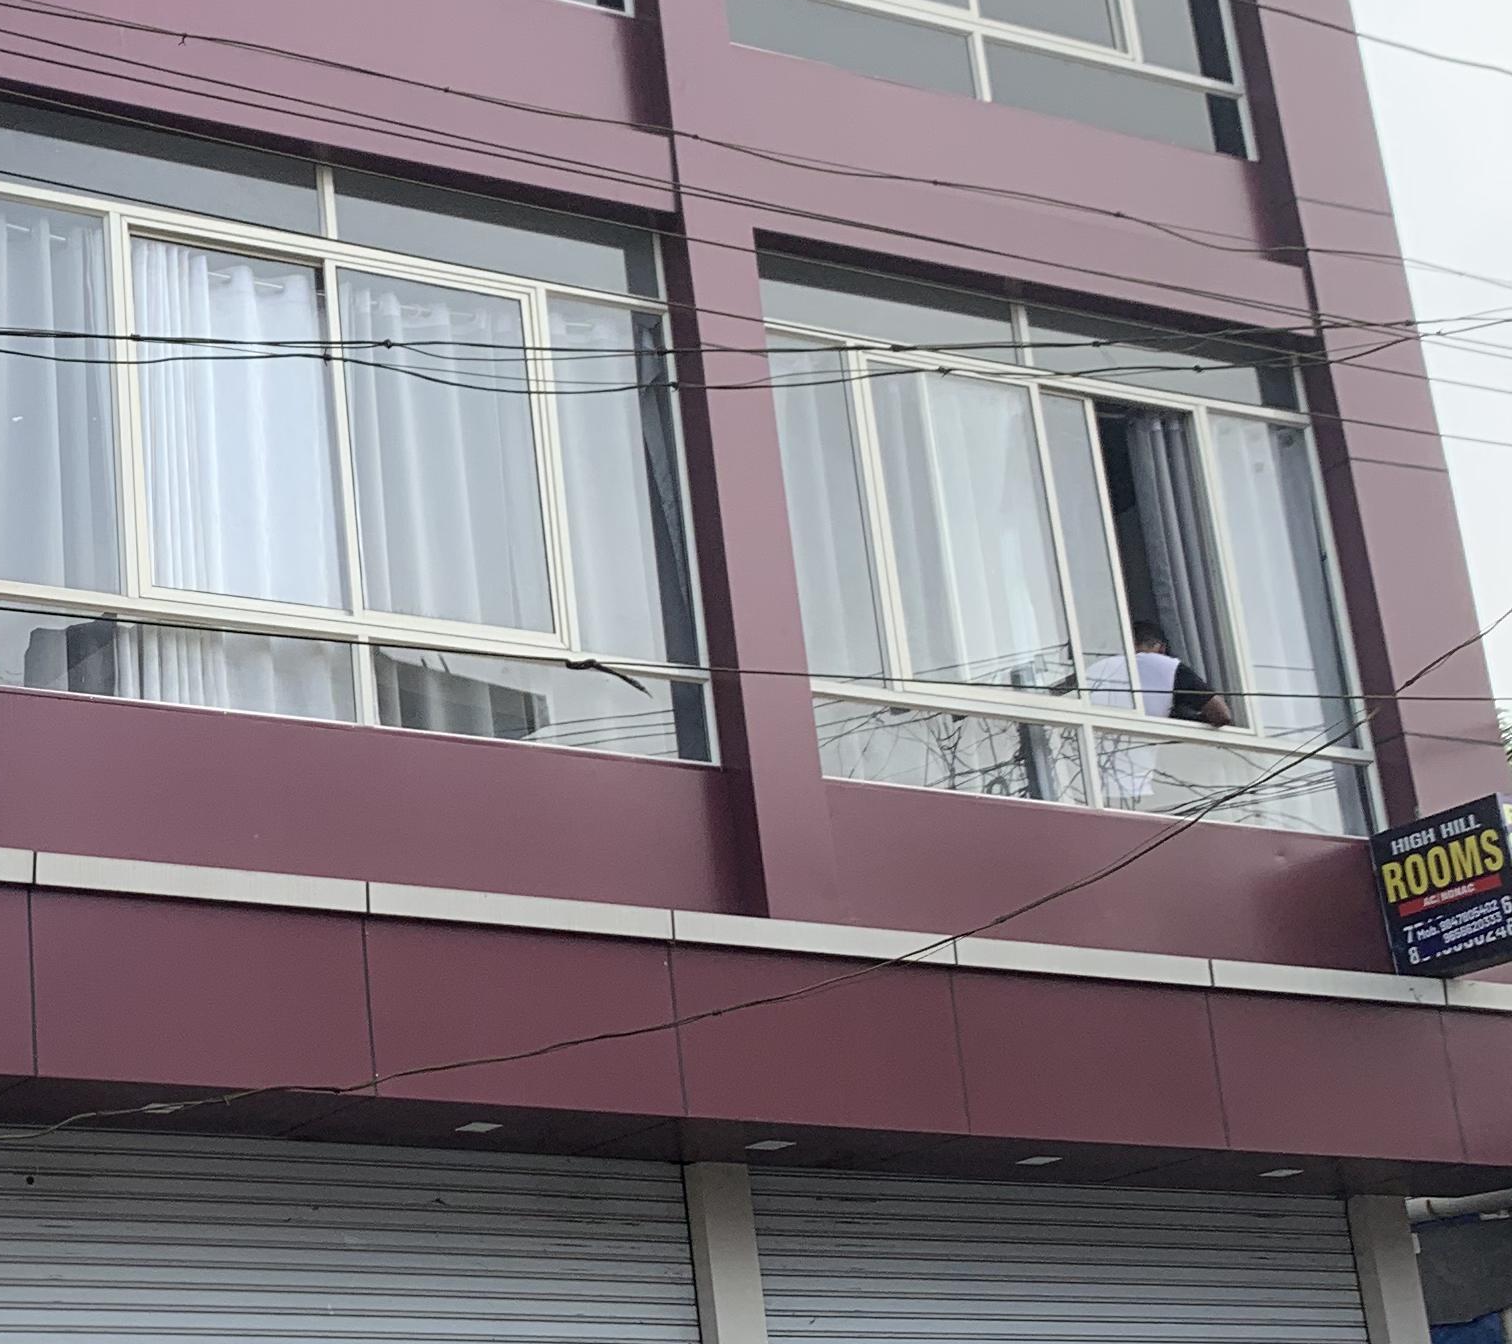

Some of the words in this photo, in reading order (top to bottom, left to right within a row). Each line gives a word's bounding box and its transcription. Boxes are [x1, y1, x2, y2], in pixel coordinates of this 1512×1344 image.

[1392, 828, 1436, 855] HIGH
[1439, 814, 1482, 838] HILL
[1381, 829, 1504, 904] ROOMS
